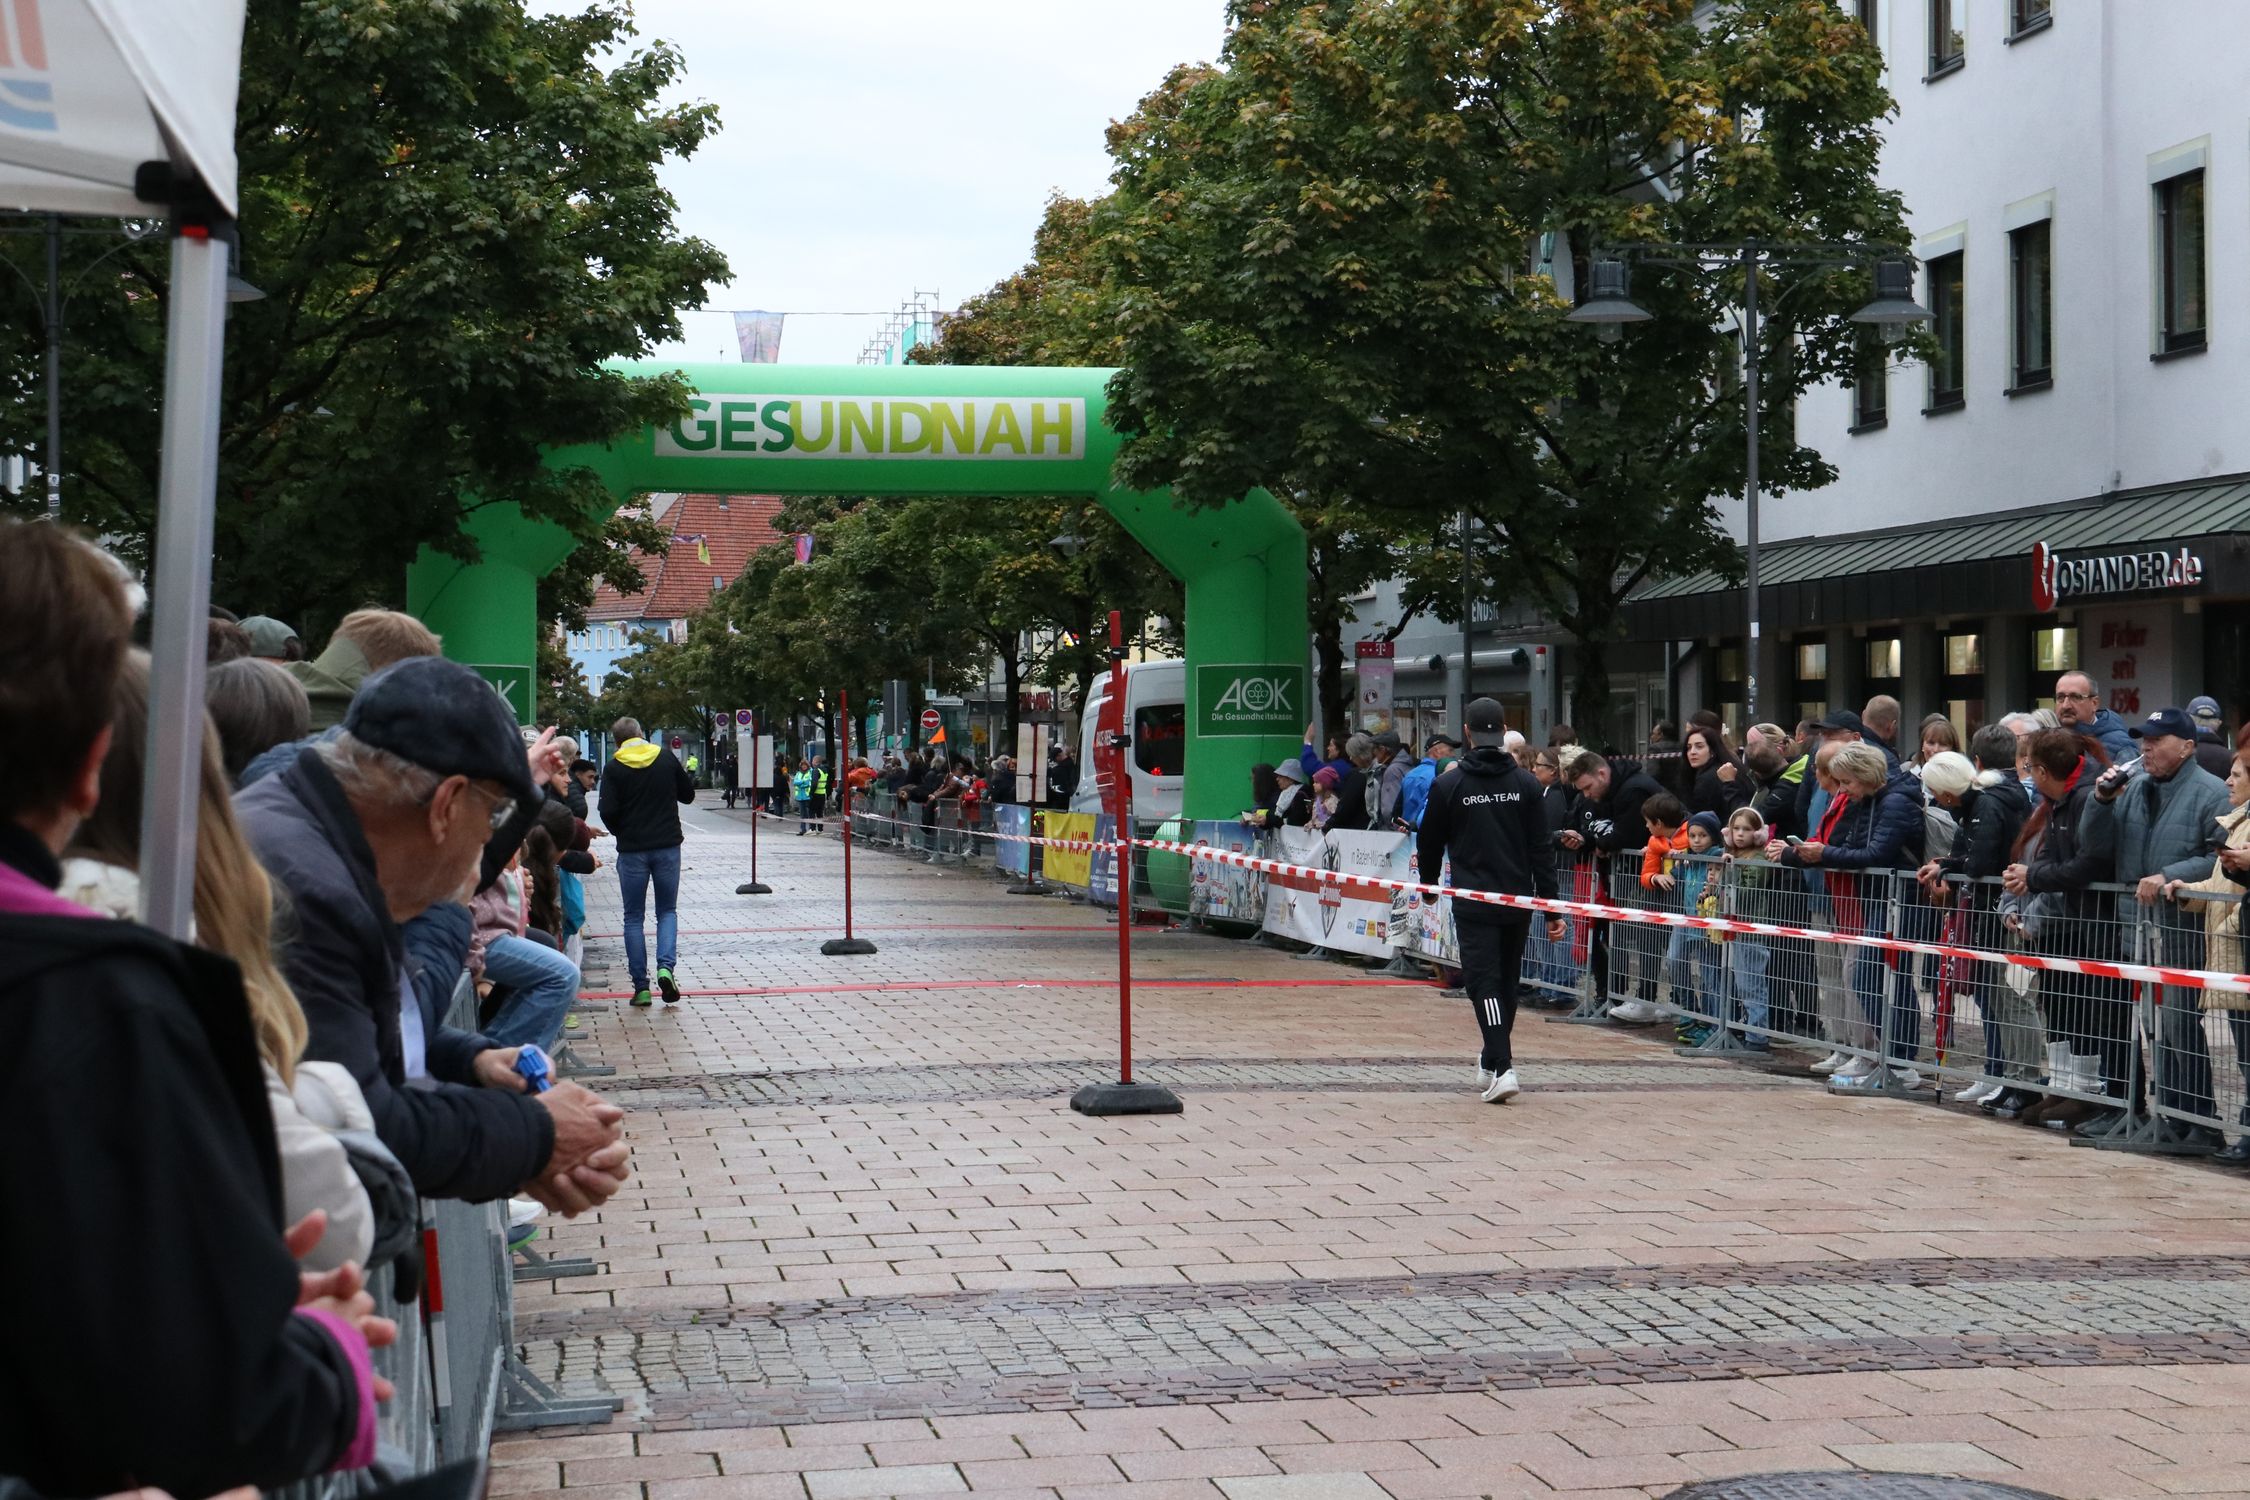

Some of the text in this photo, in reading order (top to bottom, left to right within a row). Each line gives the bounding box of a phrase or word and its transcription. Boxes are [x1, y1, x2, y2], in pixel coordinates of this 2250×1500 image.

[670, 399, 1072, 455] GESUNDNAH
[2058, 548, 2203, 596] OSIANDER.de
[1213, 677, 1293, 711] AOK
[1211, 712, 1224, 721] Die
[1462, 793, 1520, 806] ORGA-TEAM
